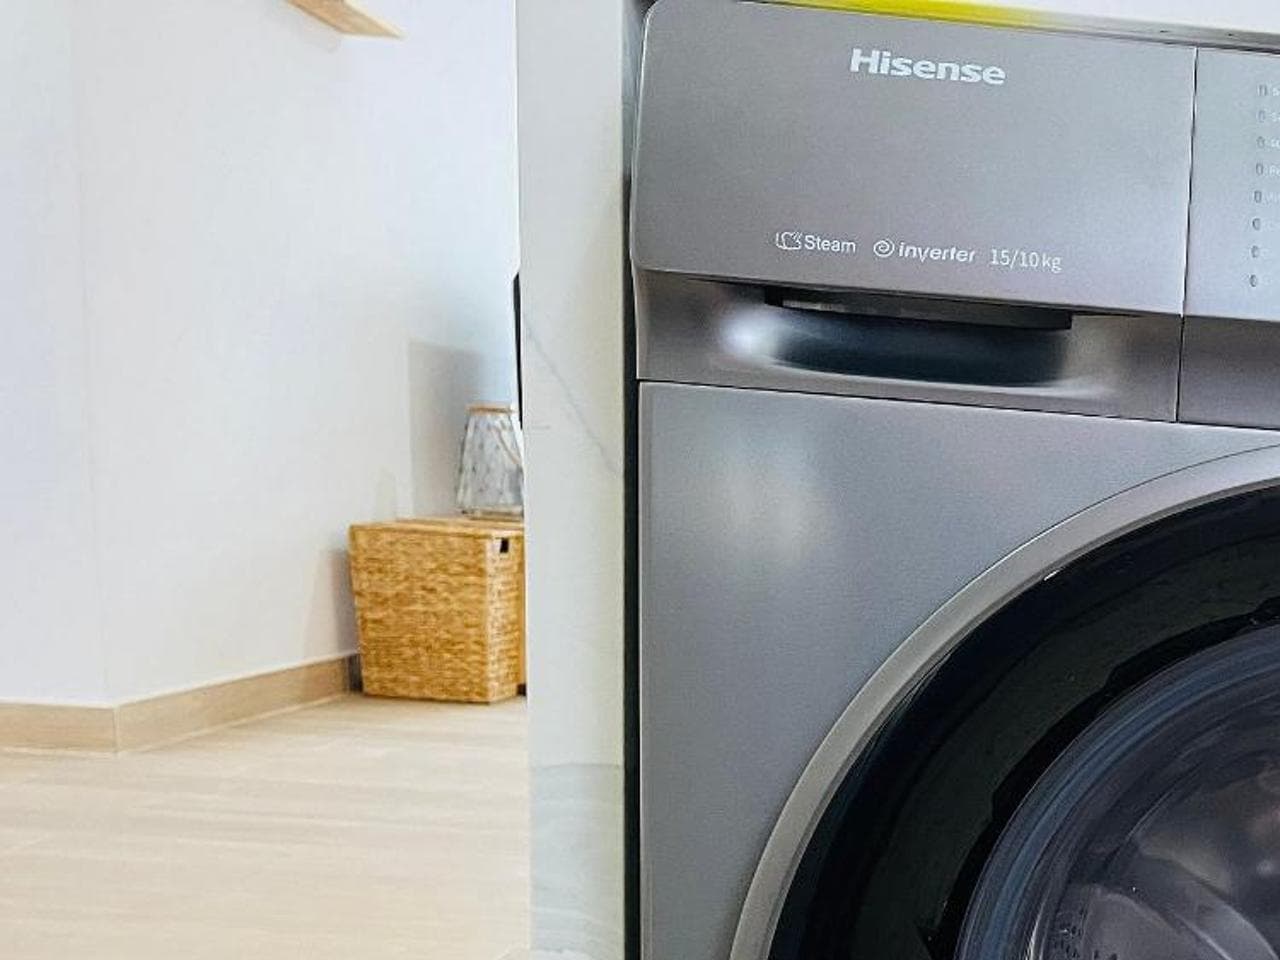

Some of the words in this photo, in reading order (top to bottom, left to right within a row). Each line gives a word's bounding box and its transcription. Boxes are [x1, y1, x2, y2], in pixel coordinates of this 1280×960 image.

[850, 48, 1006, 85] Hisense
[804, 234, 856, 253] Steam
[899, 241, 975, 263] inverter
